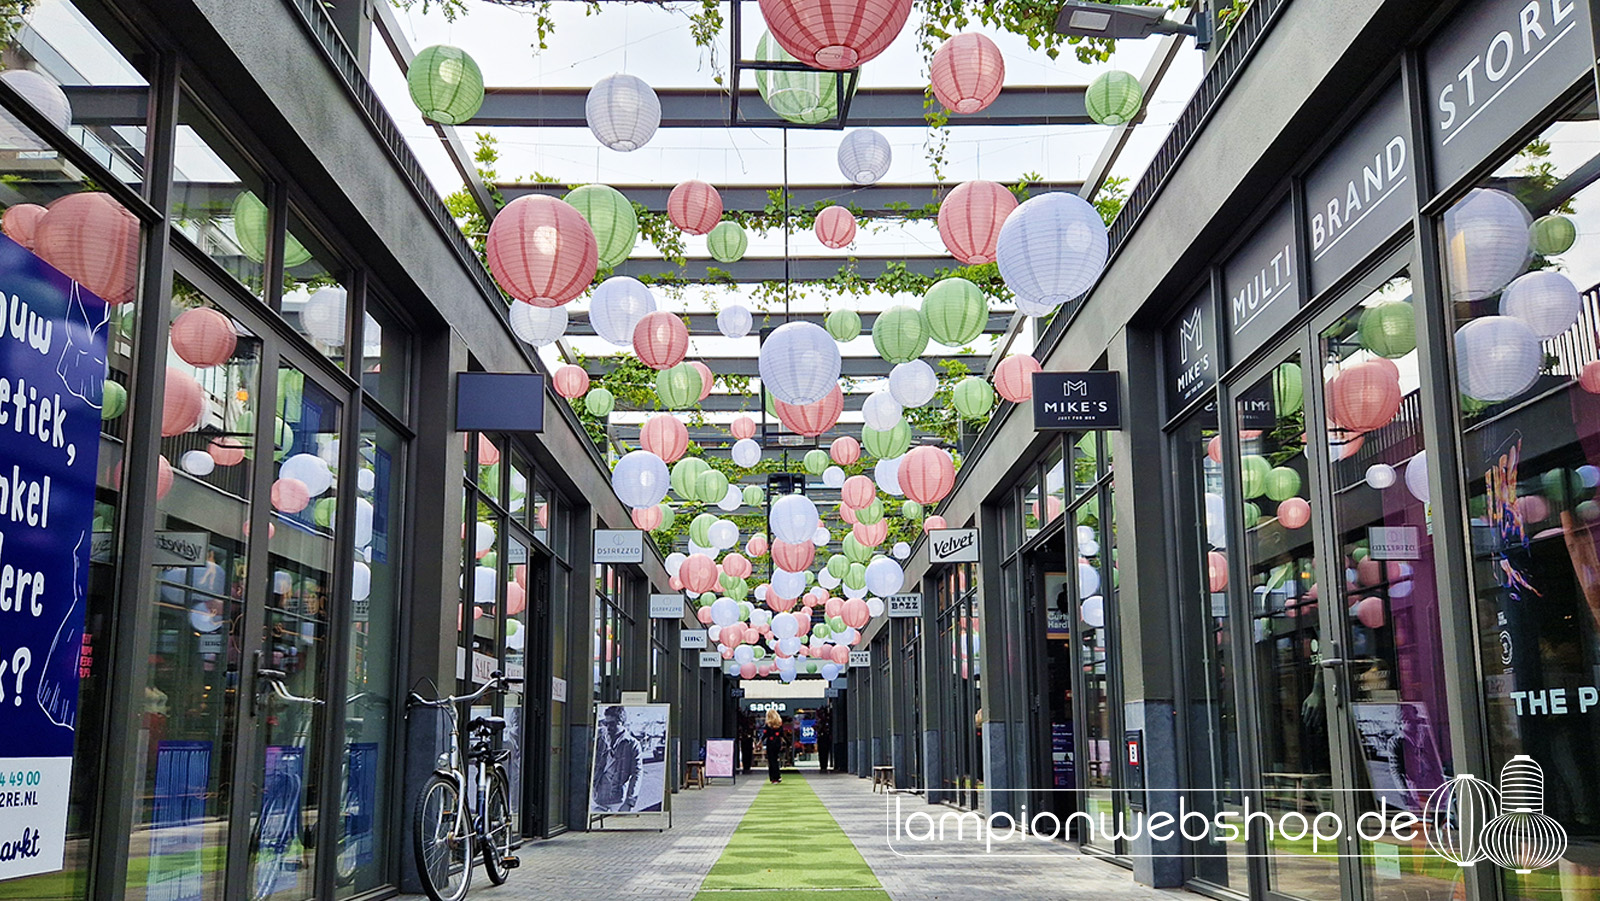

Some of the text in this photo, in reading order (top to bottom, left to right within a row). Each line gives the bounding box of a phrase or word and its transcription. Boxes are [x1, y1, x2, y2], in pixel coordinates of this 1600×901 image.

[1233, 245, 1291, 326] MULTI
[1312, 136, 1406, 251] BRAND
[1177, 354, 1209, 393] MIKE'S
[1044, 401, 1108, 413] MIKE'S
[0, 377, 76, 466] etiek,
[934, 532, 974, 558] Velvet
[750, 702, 786, 712] sacha
[1510, 686, 1599, 716] THE P
[9, 771, 24, 786] 49
[26, 770, 41, 786] 00
[0, 791, 39, 807] 2RE.NL
